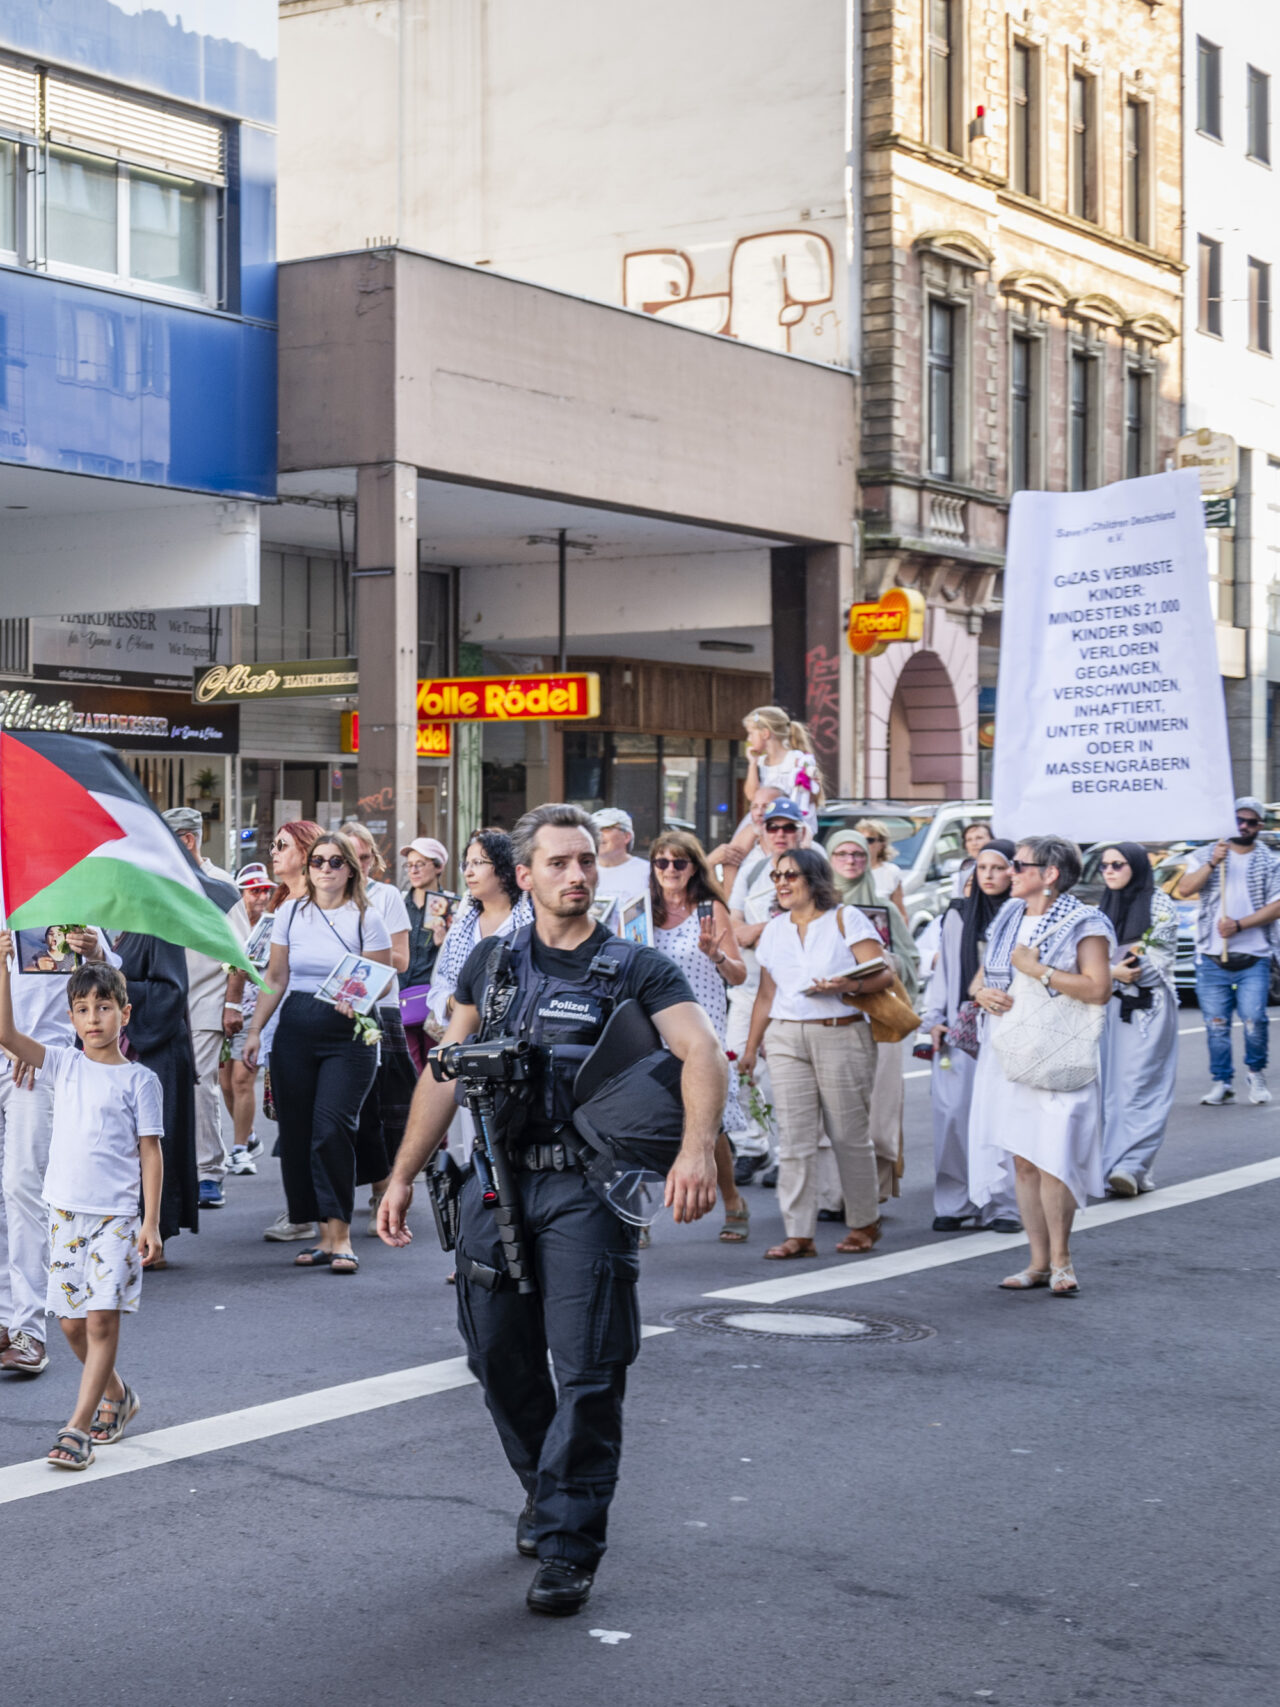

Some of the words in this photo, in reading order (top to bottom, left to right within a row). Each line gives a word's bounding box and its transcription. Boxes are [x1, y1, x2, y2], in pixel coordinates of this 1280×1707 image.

[1104, 559, 1173, 581] VERMISSTE
[1048, 603, 1141, 625] MINDESTENS
[1144, 599, 1180, 616] 21.000
[857, 612, 902, 634] Rödel
[1072, 625, 1128, 642] KINDER
[1132, 621, 1163, 636] SIND
[1080, 641, 1159, 660] VERLOREN
[1053, 679, 1181, 700] VERSCHWUNDEN,
[485, 682, 578, 720] Rödel
[1046, 723, 1099, 738] UNTER
[1104, 718, 1189, 735] TRÜMMERN
[1086, 740, 1134, 755] ODER
[1139, 739, 1153, 753] IN
[1045, 757, 1191, 776] MASSENGRÄBERN
[1072, 778, 1168, 794] BEGRABEN.
[538, 1007, 597, 1024] Videodokumentation
[549, 1000, 590, 1013] Polizei
